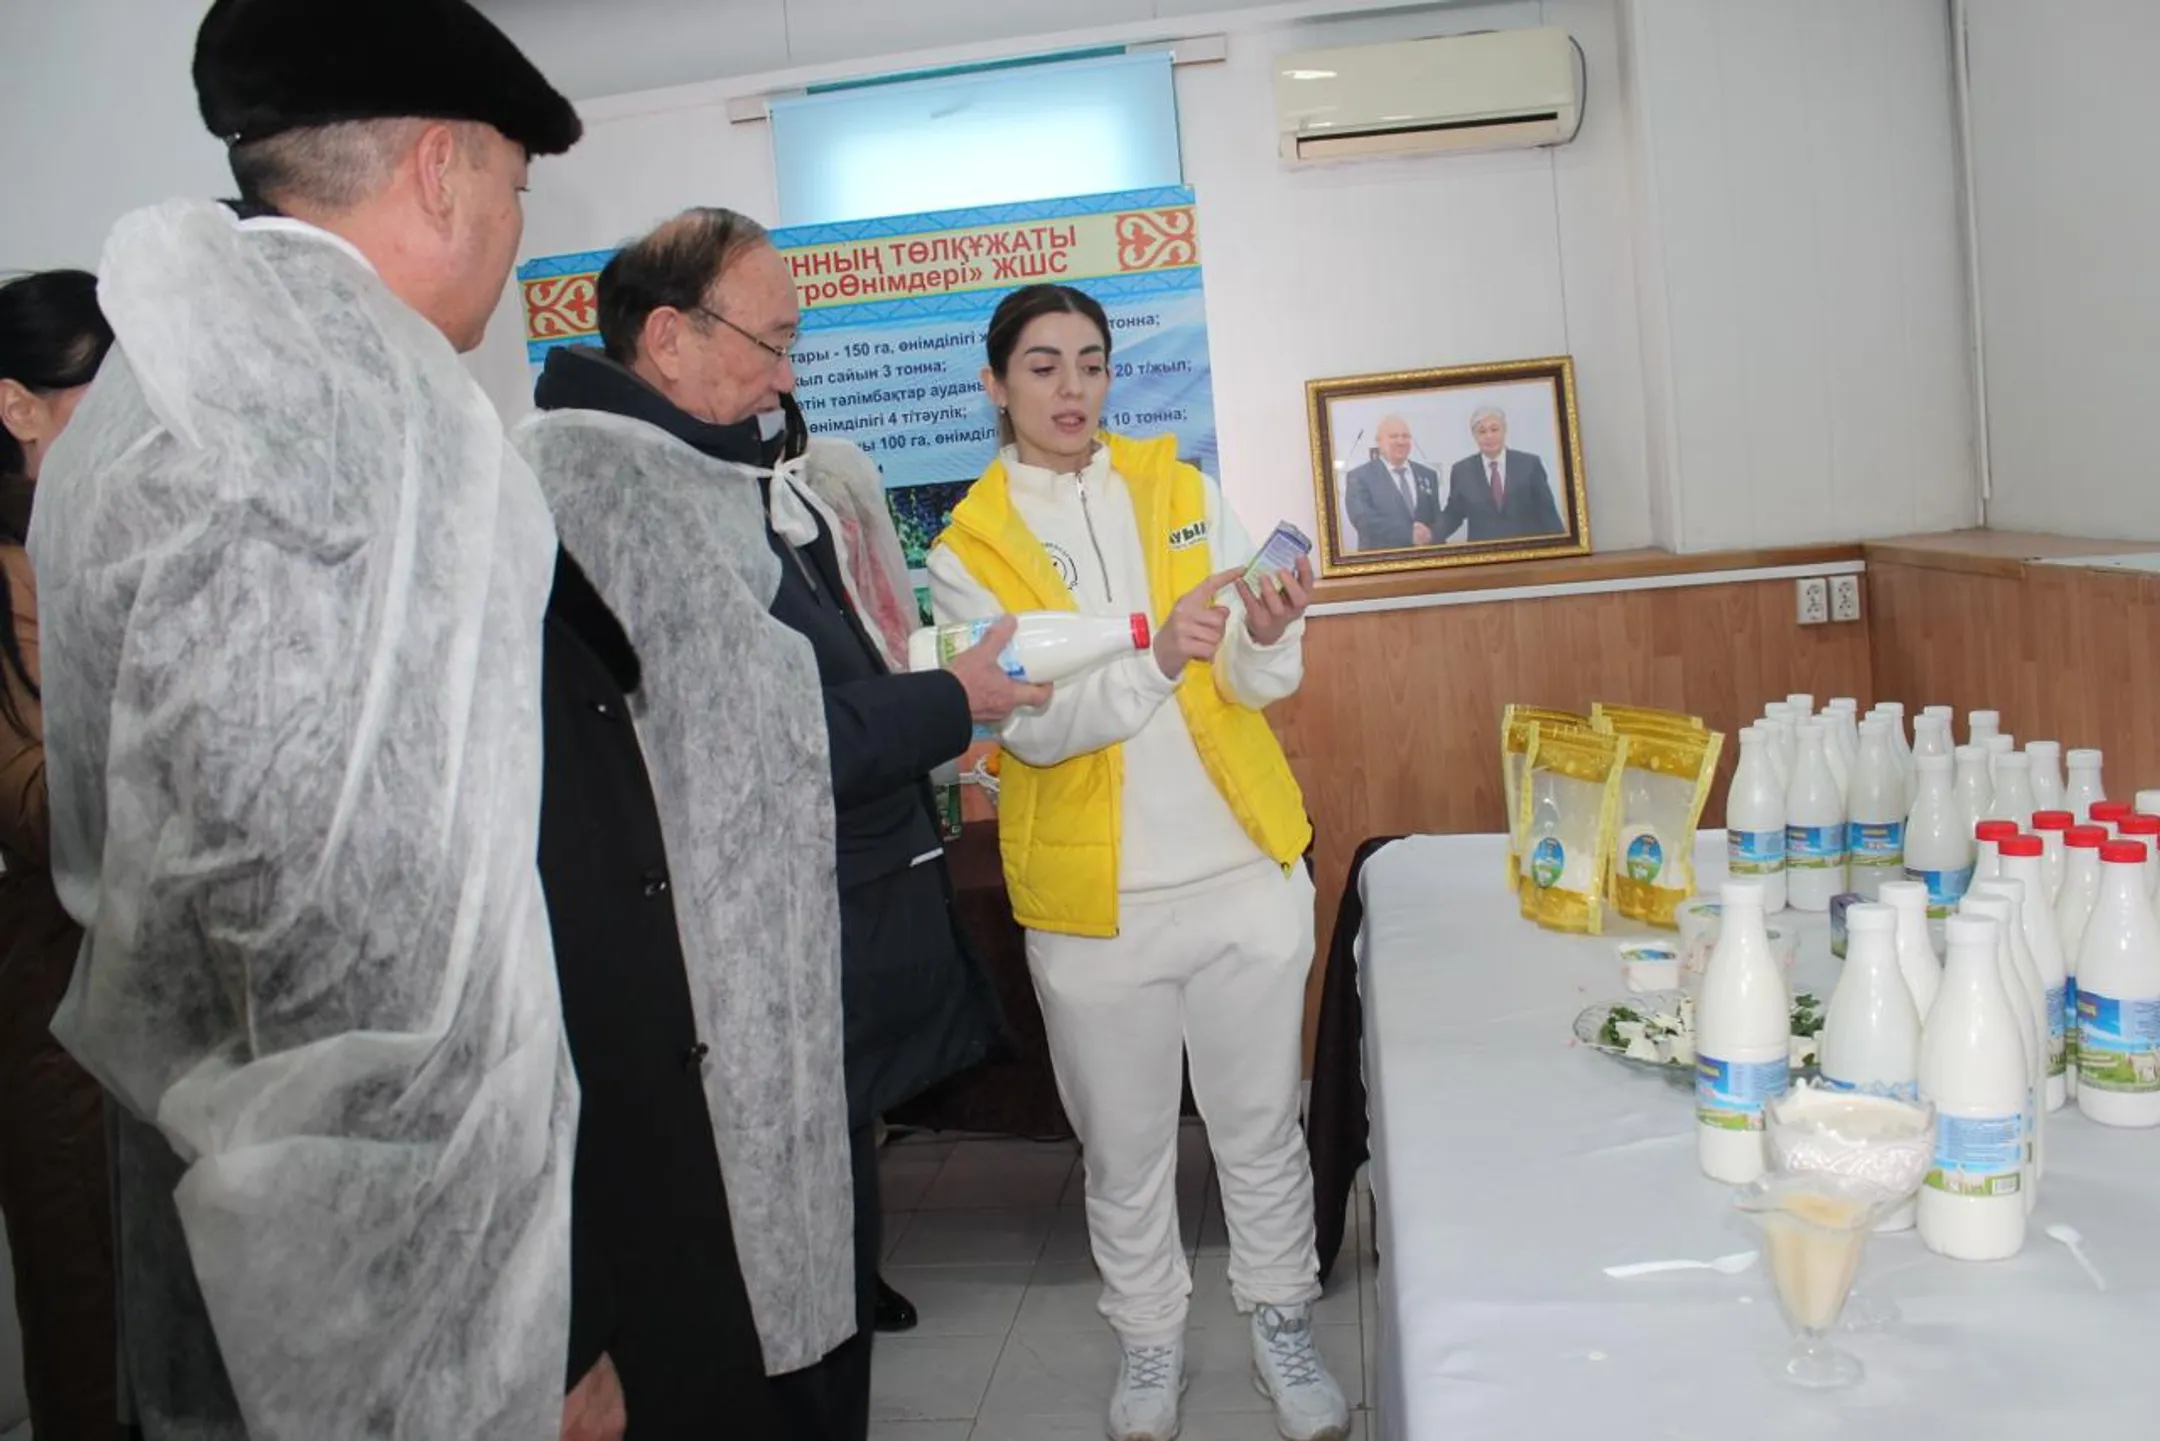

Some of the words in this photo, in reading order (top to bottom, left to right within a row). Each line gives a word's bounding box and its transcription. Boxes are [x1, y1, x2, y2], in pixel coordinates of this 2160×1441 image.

[784, 245, 883, 278] ННЫҢ
[888, 224, 1077, 267] ТӨЛҚҰЖАТЫ
[992, 250, 1068, 281] ЖШС
[845, 342, 870, 358] 150
[898, 330, 975, 352] өнімділігі
[827, 367, 879, 385] сайын
[883, 364, 891, 378] 3
[895, 360, 947, 376] тонна;
[1115, 362, 1133, 379] 20
[810, 412, 884, 433] өнімділігі
[888, 411, 898, 425] 4
[881, 434, 906, 450] 100
[1113, 411, 1131, 427] 10
